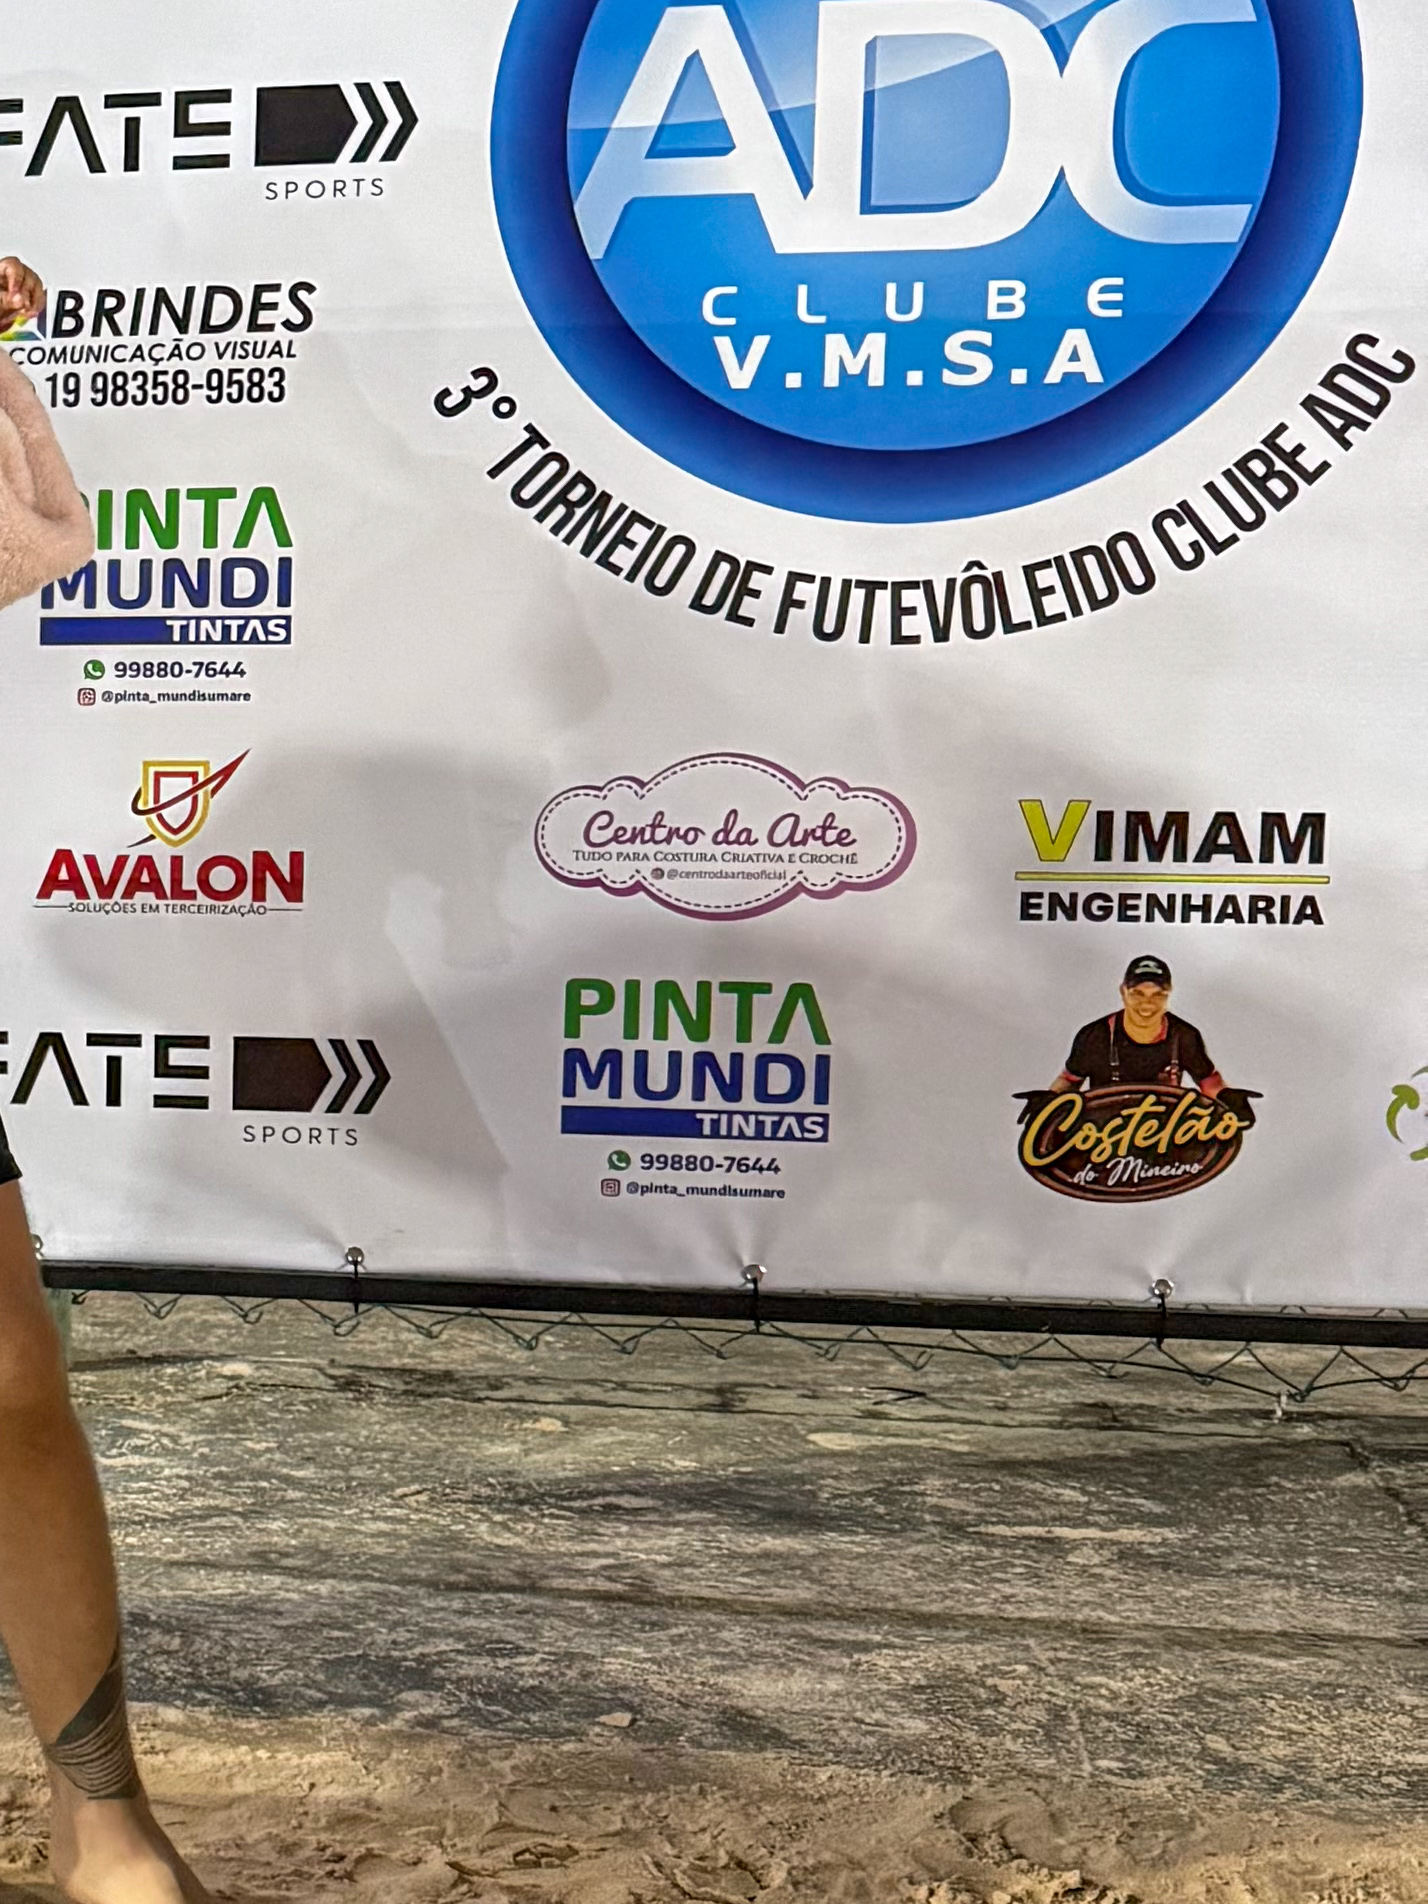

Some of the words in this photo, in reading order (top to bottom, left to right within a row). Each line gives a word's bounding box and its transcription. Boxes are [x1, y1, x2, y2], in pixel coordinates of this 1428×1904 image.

[265, 178, 385, 201] SPORTS
[702, 277, 1125, 326] CLUBE
[9, 338, 206, 367] COMUNICAÇÃO
[212, 339, 297, 361] VISUAL
[713, 328, 1104, 389] V.M.S.A
[45, 372, 80, 409] 19
[91, 367, 286, 406] 98358-9583
[486, 423, 697, 598] TORNEIO
[688, 549, 775, 628] DE
[1151, 421, 1333, 572] CLUBE
[1299, 332, 1416, 452] ADC
[80, 486, 293, 550] INTA
[40, 556, 292, 609] MUNDI
[166, 619, 287, 642] TINTAS
[114, 659, 247, 680] 99880-7644
[101, 688, 251, 705] @pinta_mundisumare
[583, 810, 705, 847] Centro
[712, 809, 759, 847] da
[767, 812, 857, 847] Arte
[1018, 799, 1327, 865] VIMAM
[573, 850, 613, 862] TUDO
[616, 851, 650, 862] PARA
[653, 850, 718, 863] COSTURA
[721, 851, 785, 864] CRIATIVA
[788, 853, 795, 863] E
[36, 849, 304, 903] AVALON
[68, 900, 137, 916] SOLUÇÕES
[141, 902, 160, 914] EM
[164, 901, 267, 917] TERCEIRIZAÇÃO
[1019, 891, 1325, 926] ENGENHARIA
[563, 978, 832, 1046] PINTA
[561, 1047, 831, 1106] MUNDI
[243, 1124, 359, 1147] SPORTS
[695, 1112, 824, 1139] TINTAS
[1022, 1091, 1249, 1167] Costelão
[639, 1152, 781, 1175] 99880-7644
[1072, 1163, 1099, 1185] do
[1106, 1156, 1203, 1186] Mineiro
[625, 1180, 786, 1200] @pinta_mundisumare
